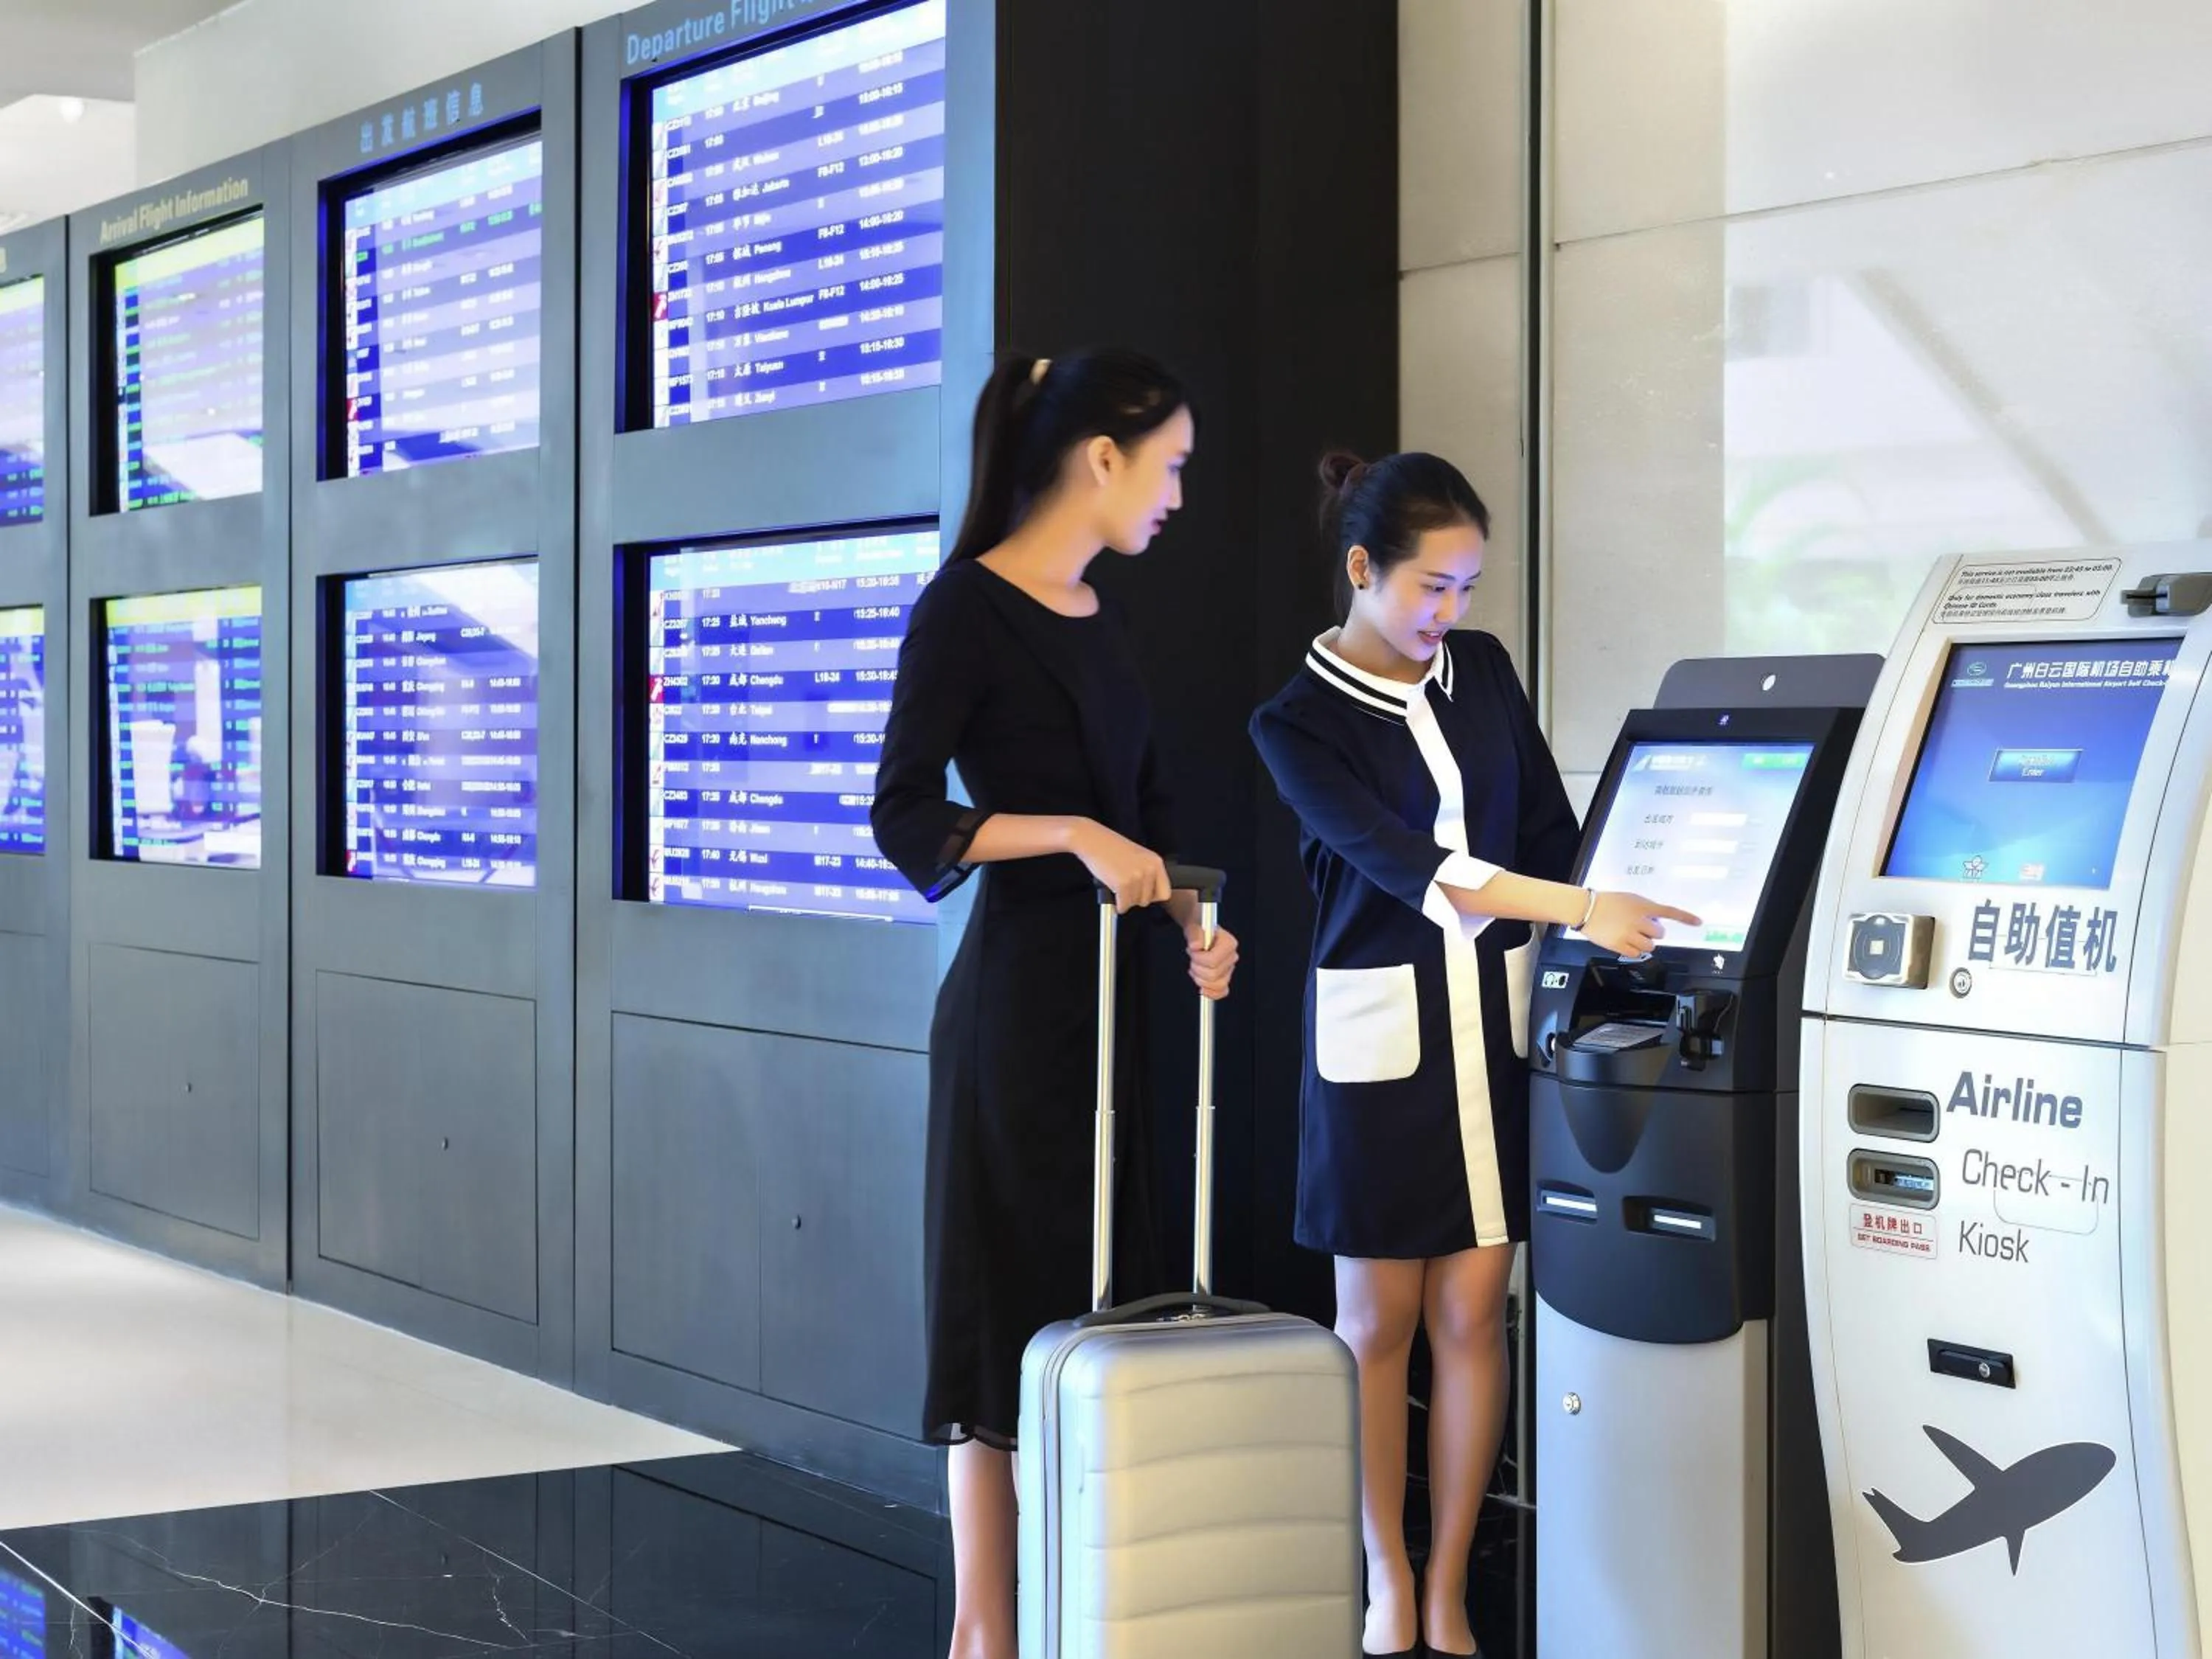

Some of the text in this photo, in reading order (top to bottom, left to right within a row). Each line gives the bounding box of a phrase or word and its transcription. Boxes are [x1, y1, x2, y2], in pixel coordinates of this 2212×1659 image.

[627, 11, 725, 65] Departure
[100, 177, 248, 244] Arrival Flight Information
[1968, 899, 2118, 973] 自助值机
[1947, 1071, 2083, 1129] Airline
[1863, 1213, 1922, 1235] 登机牌出口
[1873, 1235, 1909, 1248] BOARDING
[1958, 1220, 2029, 1265] Kiosk
